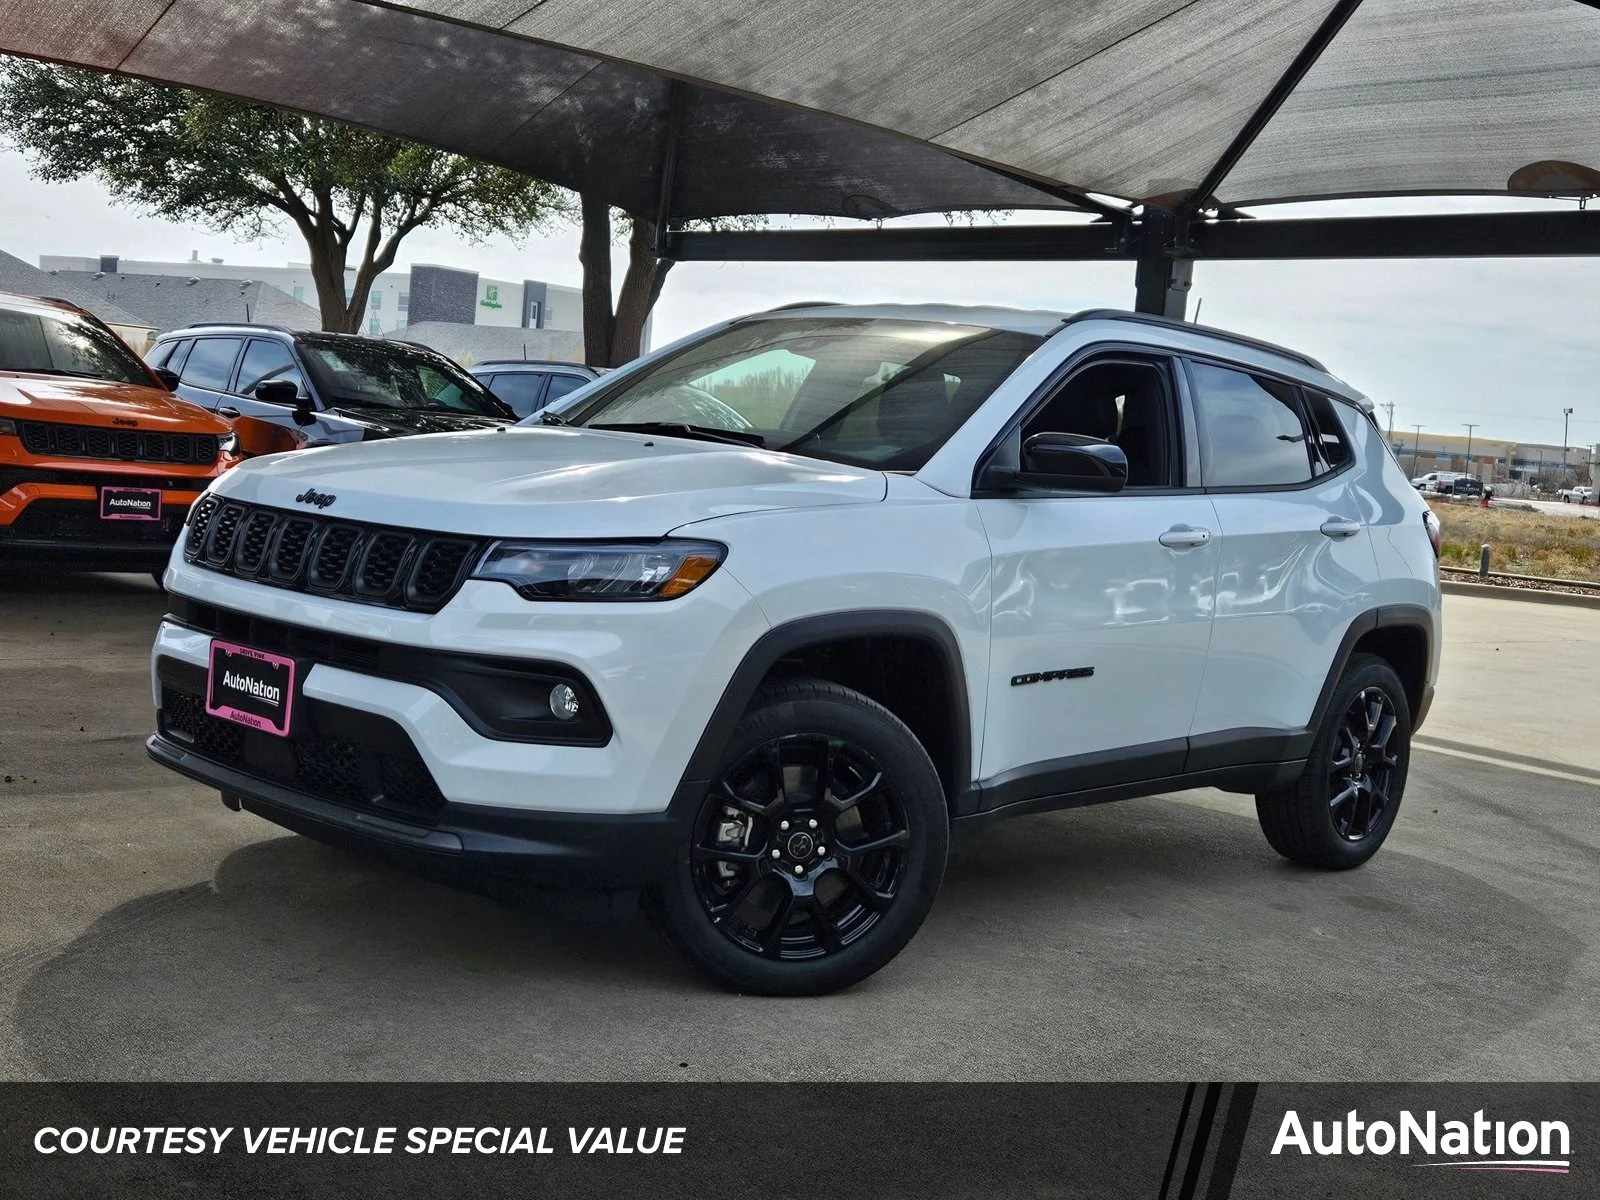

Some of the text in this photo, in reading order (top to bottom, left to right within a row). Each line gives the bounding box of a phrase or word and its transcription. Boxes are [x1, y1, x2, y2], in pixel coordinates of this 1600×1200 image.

[112, 418, 138, 427] Jeep
[109, 499, 151, 507] AutoNation
[296, 488, 337, 509] Jeep
[222, 670, 280, 700] AutoNation
[1011, 667, 1095, 686] COMPASS
[230, 711, 262, 727] AutoNation
